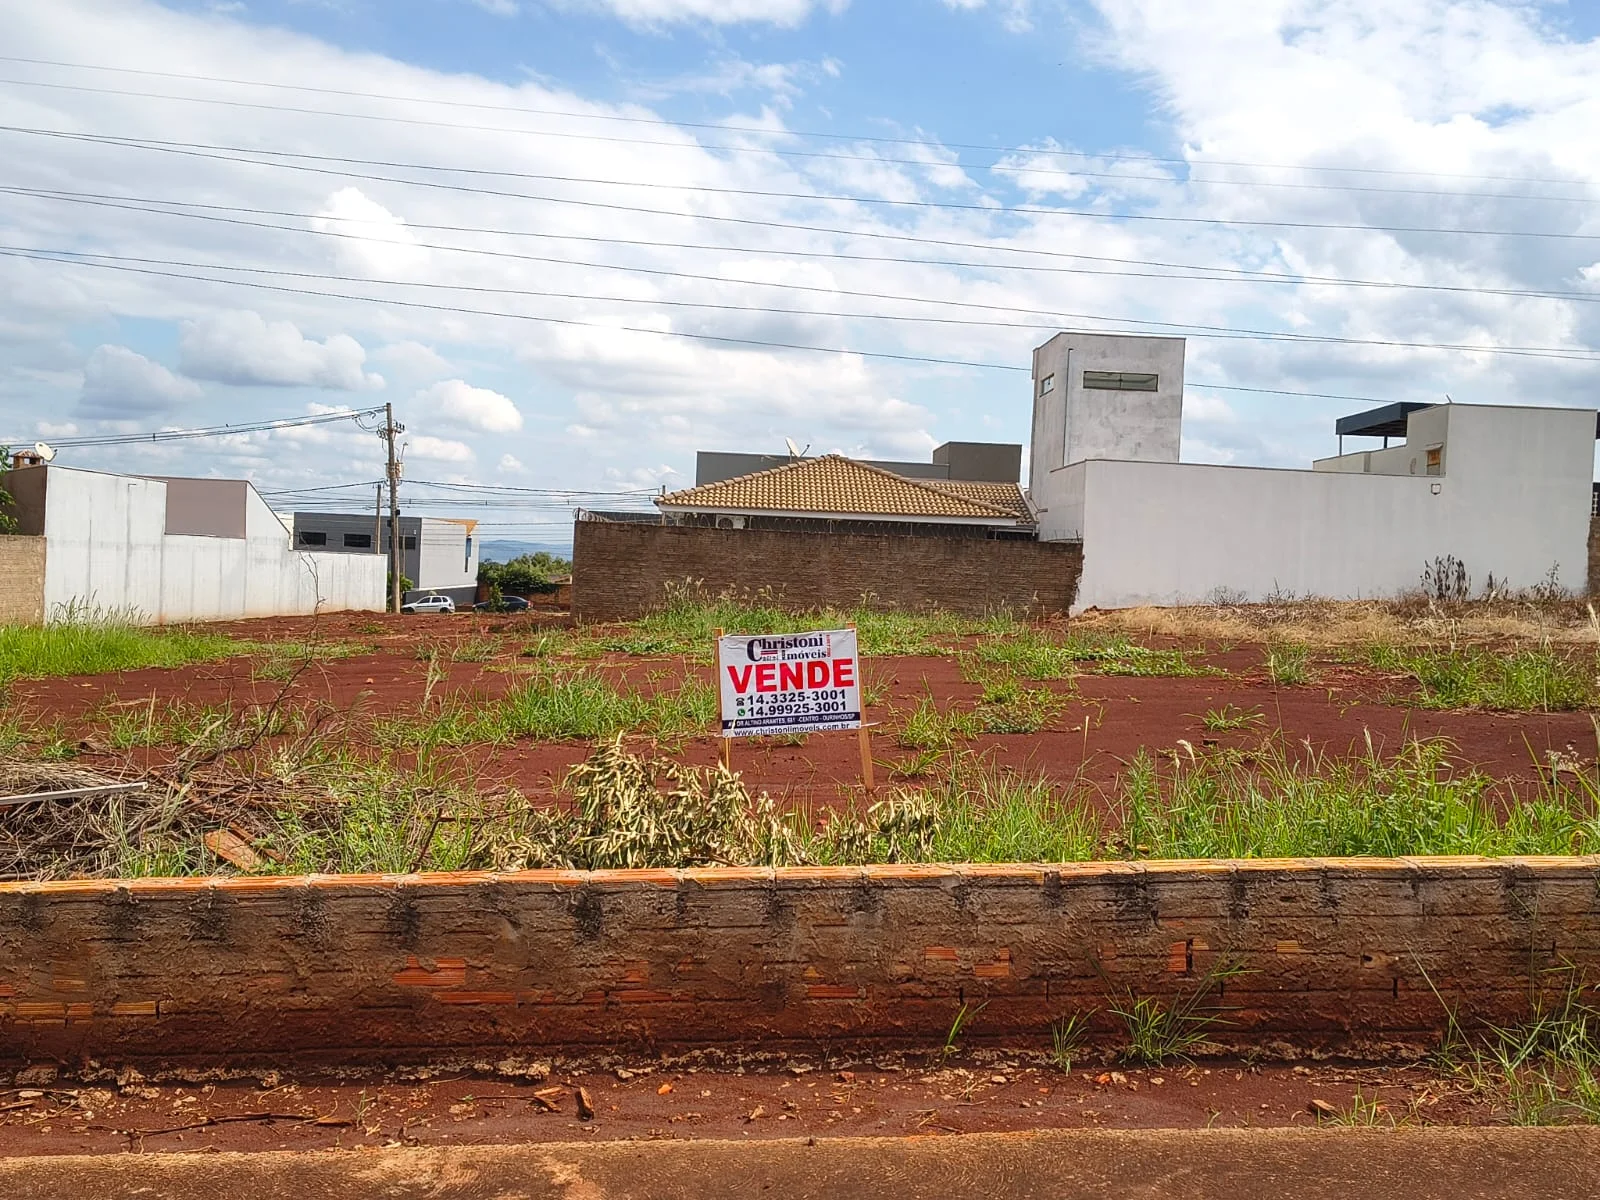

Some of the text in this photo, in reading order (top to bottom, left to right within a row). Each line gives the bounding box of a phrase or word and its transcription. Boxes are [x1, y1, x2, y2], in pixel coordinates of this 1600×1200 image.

[747, 634, 823, 662] Christoni
[781, 649, 826, 661] Imóveis
[727, 658, 855, 694] VENDE
[747, 689, 846, 706] 14.3325-3001
[748, 701, 846, 717] 14.99925-3001
